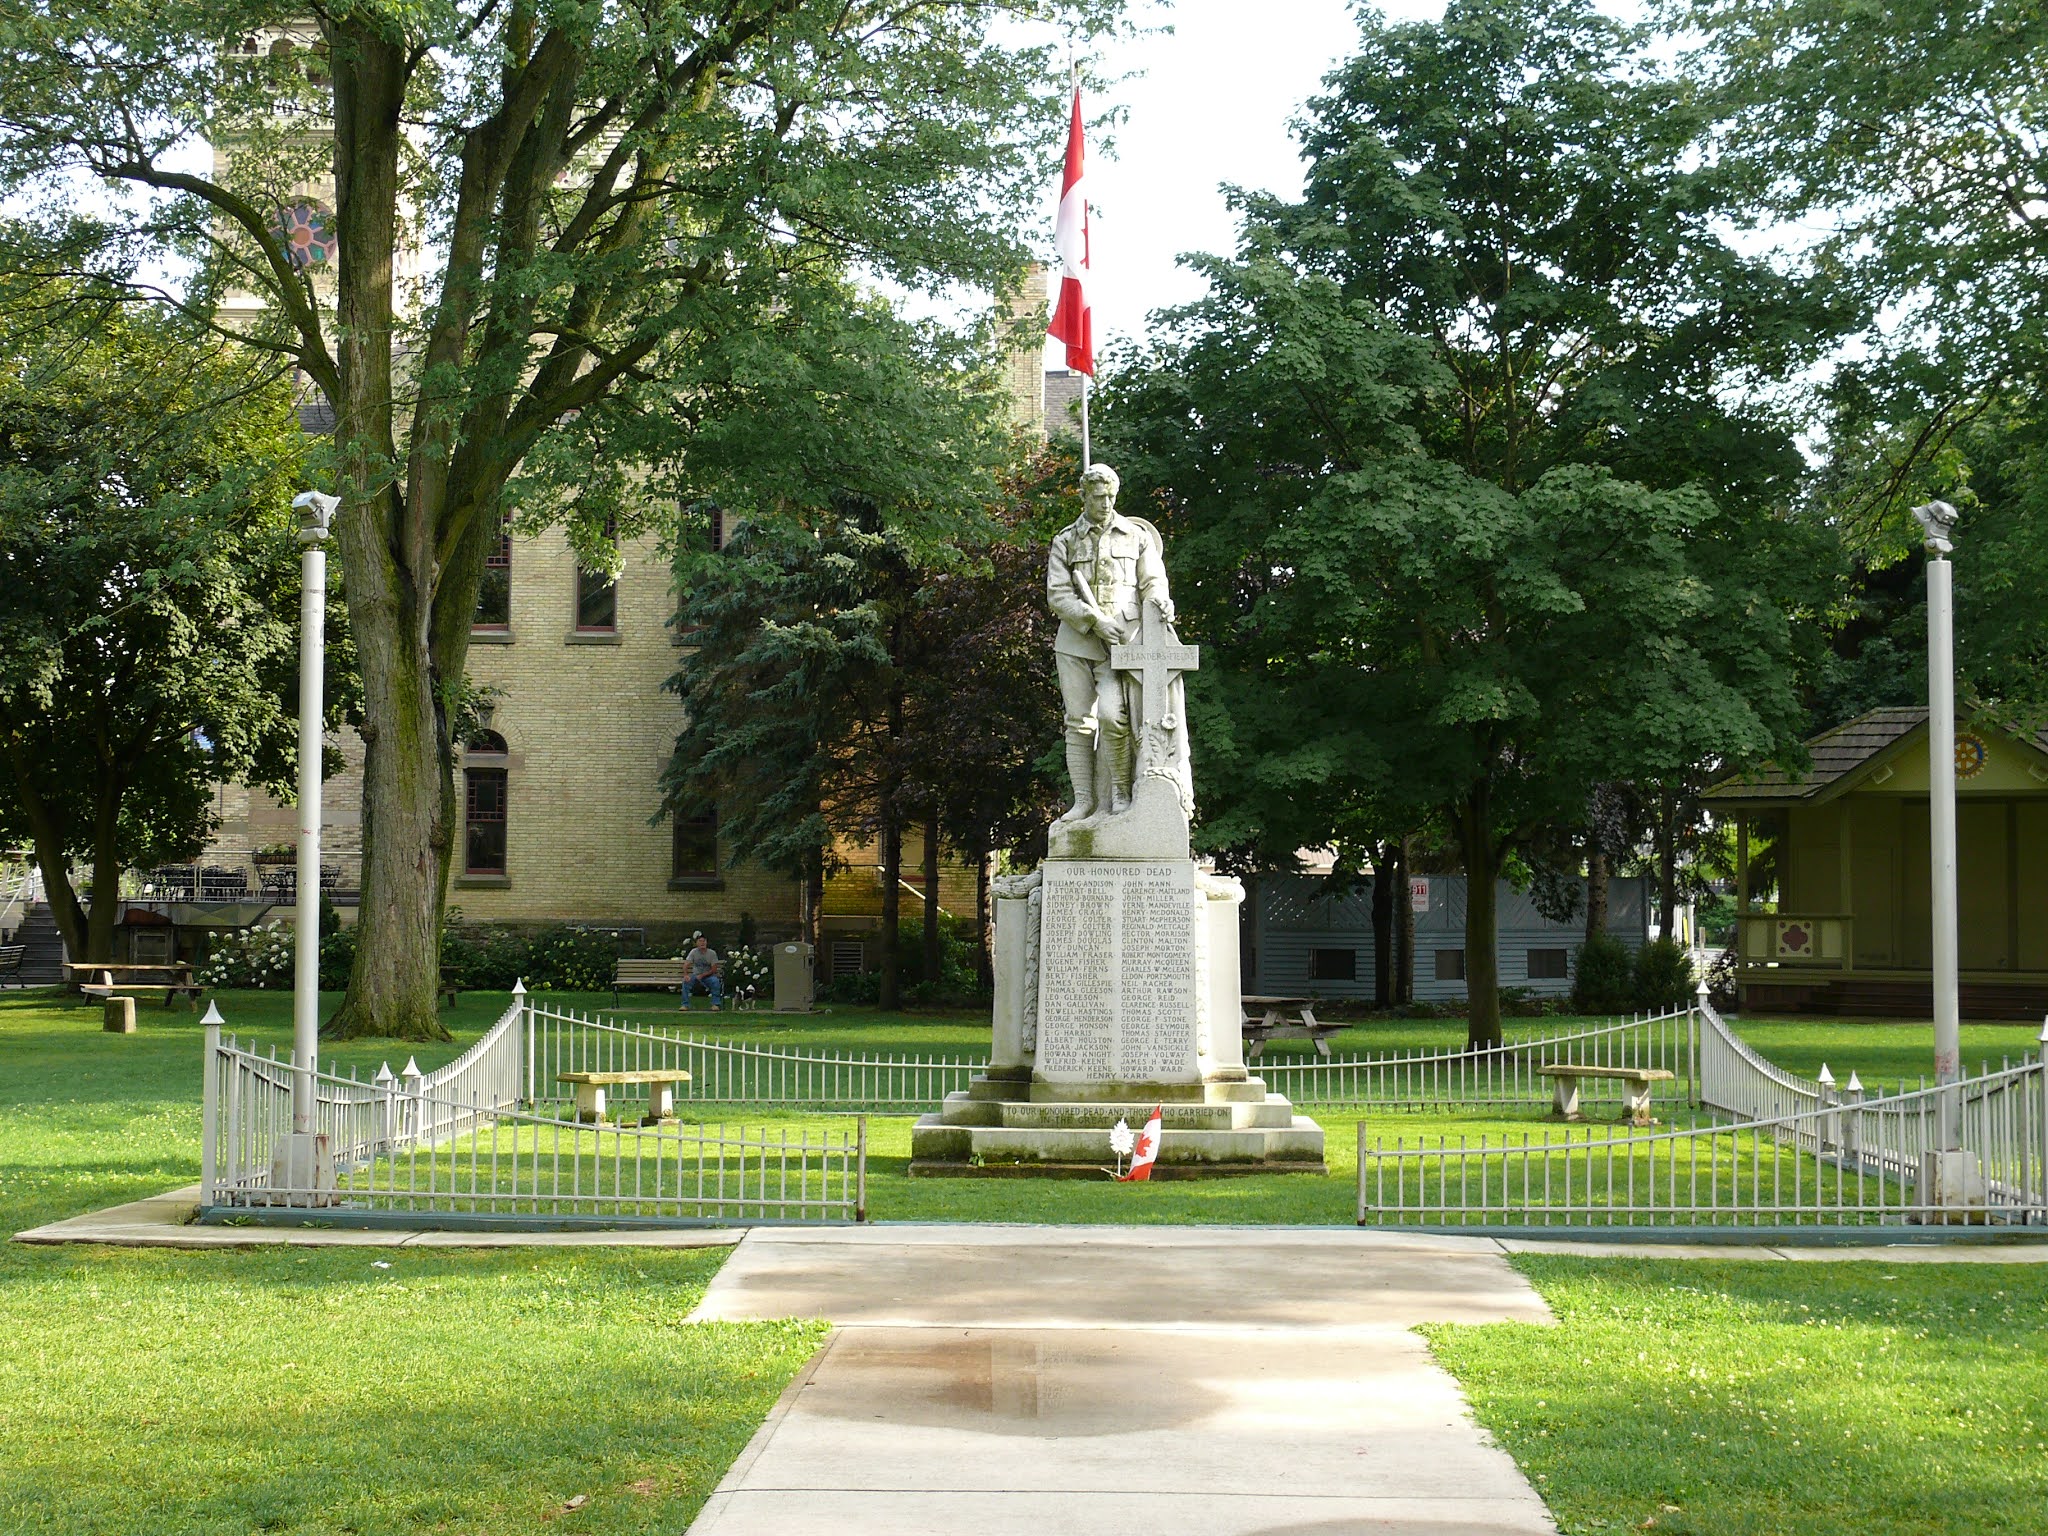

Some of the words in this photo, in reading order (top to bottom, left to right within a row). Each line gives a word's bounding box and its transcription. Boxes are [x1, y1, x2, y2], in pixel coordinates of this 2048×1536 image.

[1066, 867, 1086, 876] OUR
[1091, 867, 1140, 876] HONOURED
[1146, 868, 1172, 876] DEAD
[1412, 886, 1426, 894] 911
[1006, 1107, 1017, 1116] TO
[1021, 1107, 1036, 1116] OUR
[1039, 1107, 1080, 1116] HONOURED
[1083, 1107, 1105, 1116] DEAD
[1108, 1107, 1124, 1116] AND
[1041, 1116, 1050, 1124] IN
[1055, 1116, 1072, 1124] THE
[1078, 1116, 1109, 1124] GREAT
